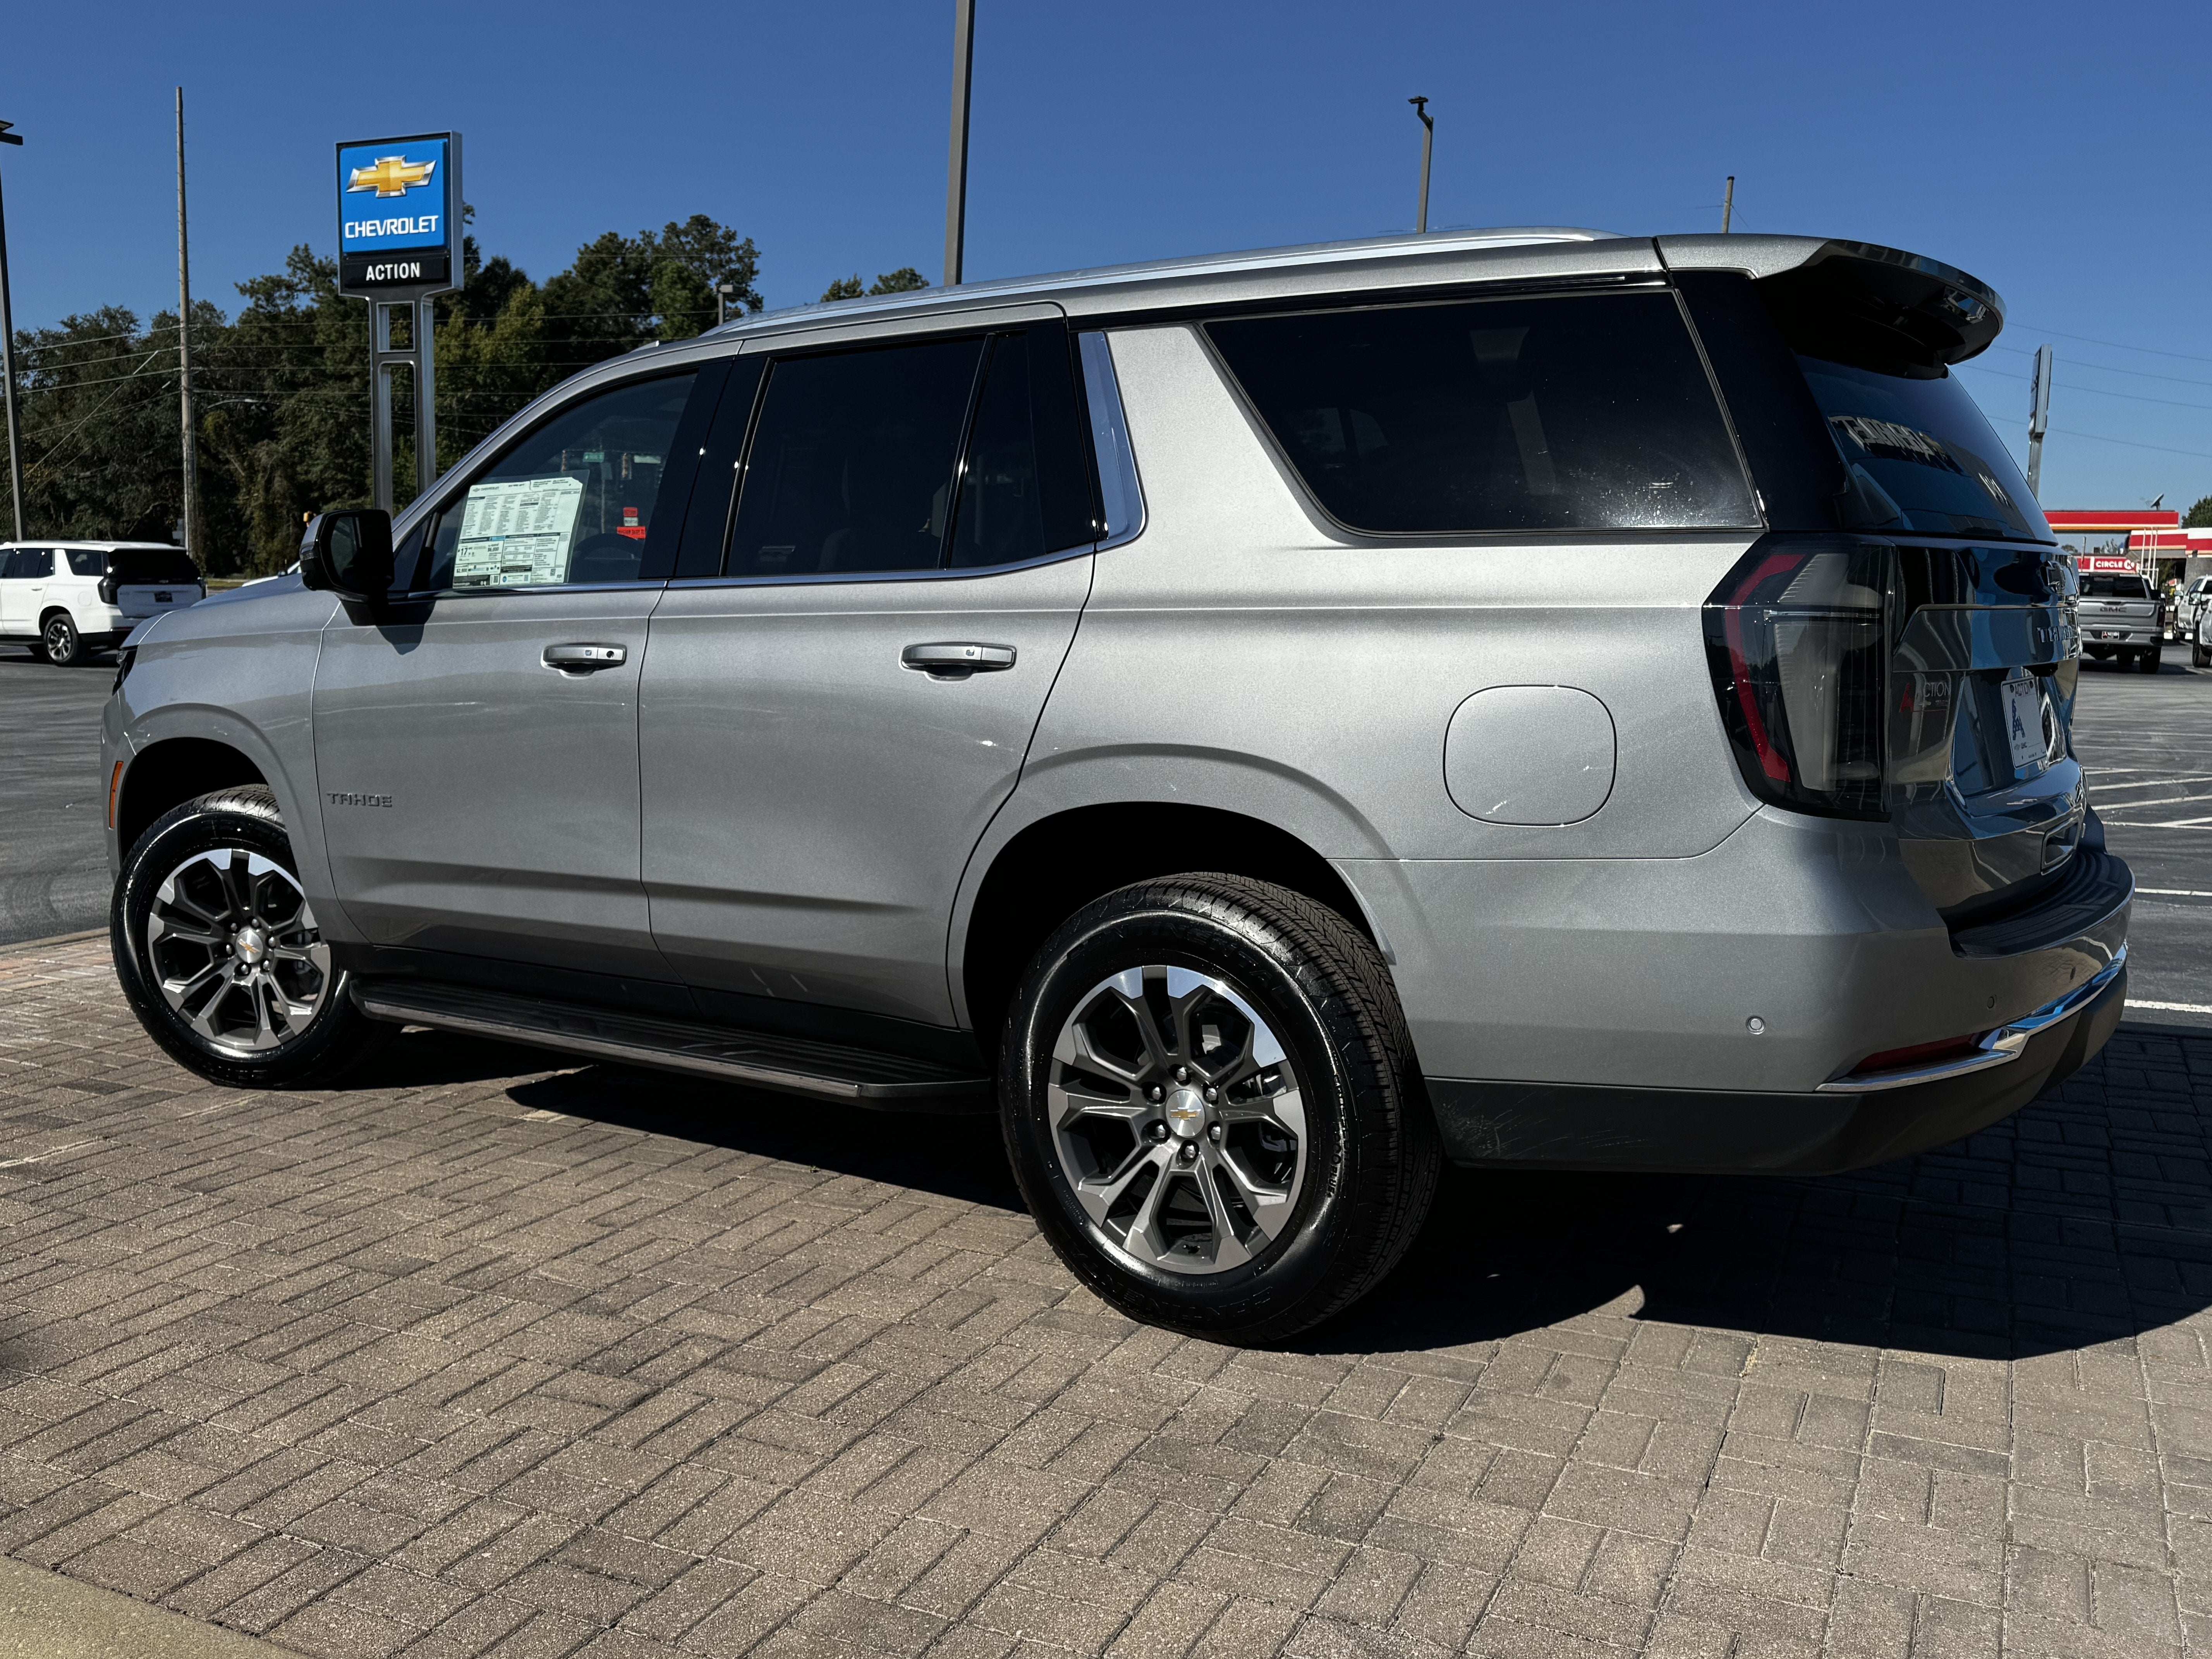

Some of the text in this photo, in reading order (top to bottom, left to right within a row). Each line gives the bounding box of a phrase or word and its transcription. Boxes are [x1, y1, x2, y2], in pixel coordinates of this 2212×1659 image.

[345, 215, 438, 238] CHEVROLET
[366, 262, 420, 281] ACTION
[327, 793, 392, 807] TAHOE
